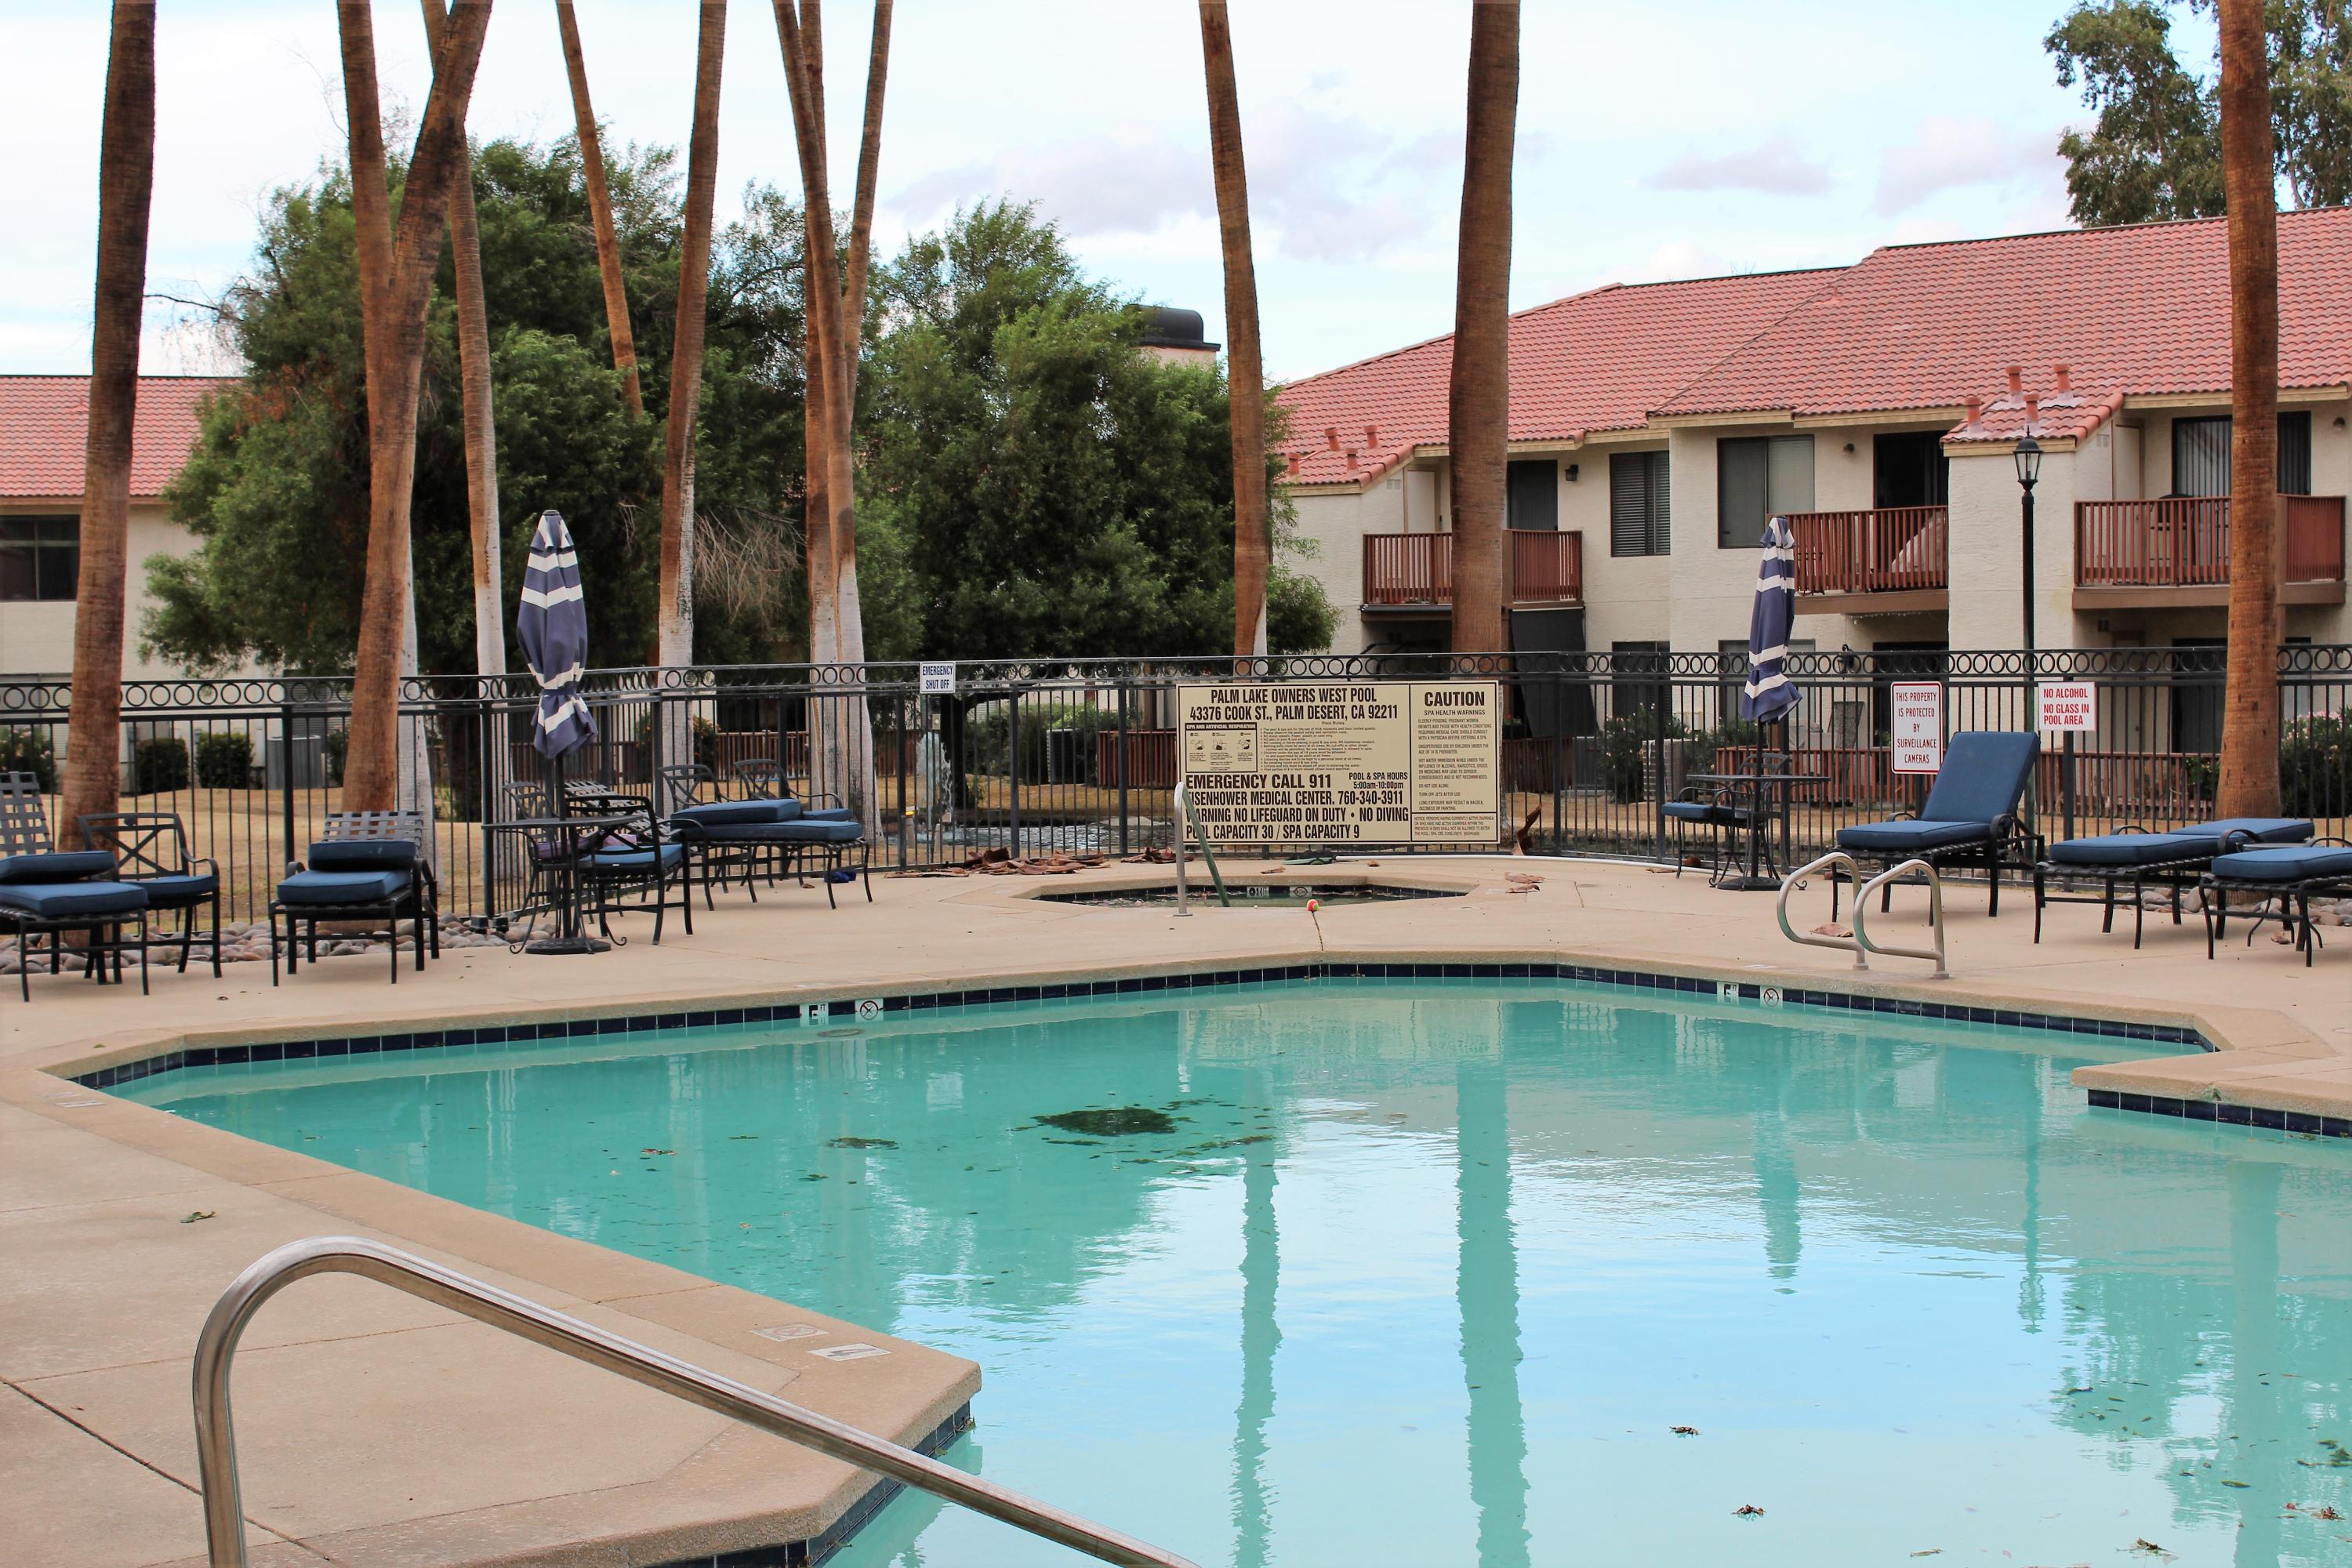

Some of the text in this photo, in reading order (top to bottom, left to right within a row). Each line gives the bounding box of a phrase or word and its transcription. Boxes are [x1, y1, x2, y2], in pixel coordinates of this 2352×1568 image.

[923, 666, 953, 675] EMERGENCY
[926, 680, 938, 689] SHUT
[1211, 688, 1377, 703] PALM LAKE OWNERS WEST POOL
[1896, 692, 1936, 702] THIS PROPERTY
[2044, 688, 2088, 698] NO ALCOHOL
[1425, 691, 1484, 706] CAUTION
[1190, 705, 1397, 721] 43376 COOK ST., PALM DESERT, CA 92211
[1906, 708, 1934, 717] PROTECTED
[2044, 703, 2089, 713] NO GLASS IN
[2044, 715, 2083, 725] POOL AREA
[1914, 724, 1920, 732] BY
[1897, 739, 1936, 748] SURVEILLANCE
[1904, 754, 1929, 764] CAMERAS
[1186, 775, 1331, 789] EMERGENCY CALL 911
[1189, 791, 1402, 806] ISENHOWER MEDICAL CENTER. 760-340-3911
[1235, 808, 1247, 822] NO
[1251, 808, 1301, 822] LIFEGUARD
[1305, 808, 1319, 822] ON
[1323, 808, 1346, 822] DUTY
[1359, 808, 1373, 822] NO
[1377, 808, 1408, 822] DIVING
[1214, 825, 1258, 839] CAPACITY
[1262, 825, 1273, 839] 30
[1276, 825, 1280, 840] /
[1283, 825, 1301, 839] SPA
[1305, 825, 1350, 838] CAPACITY
[1354, 825, 1359, 838] 9
